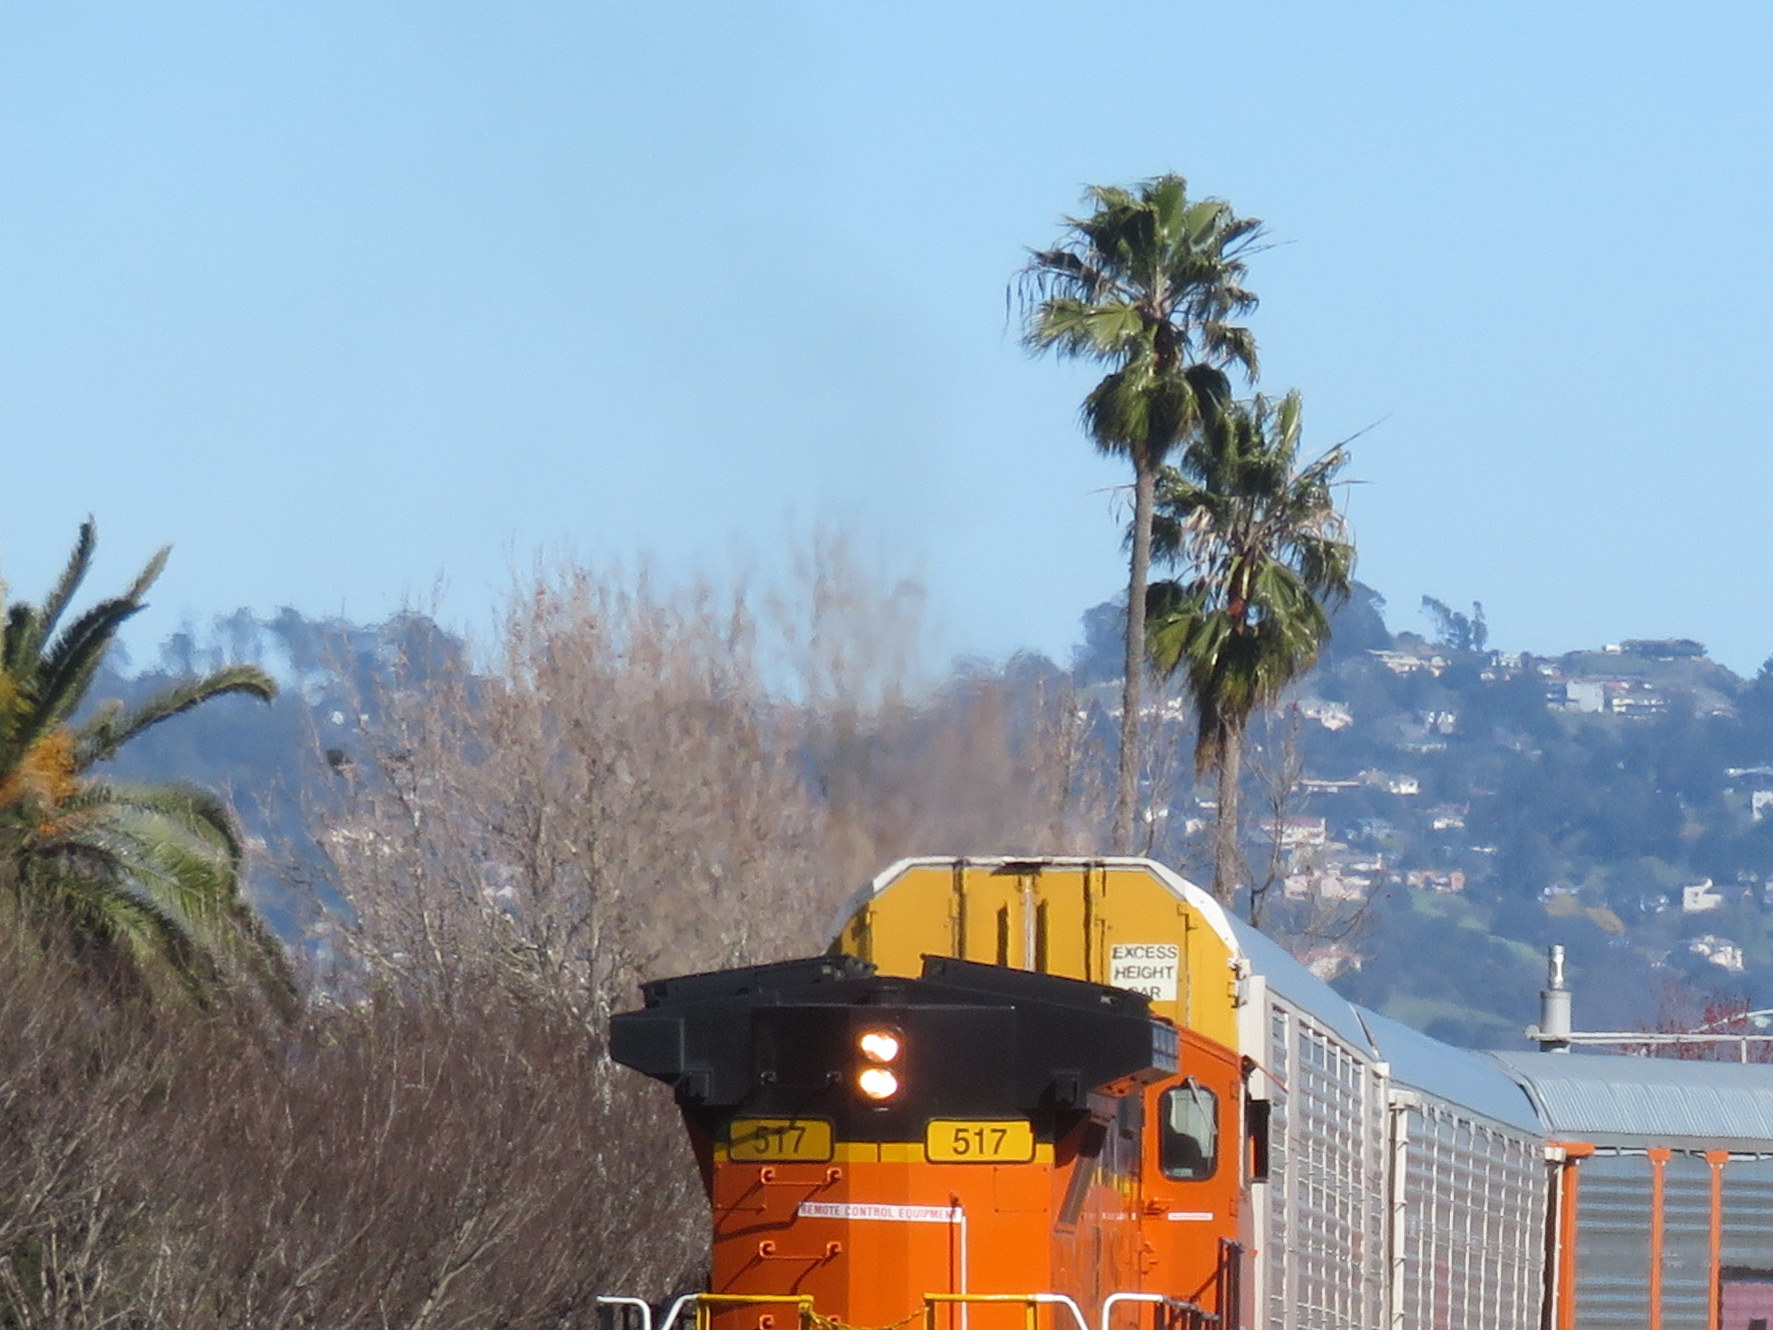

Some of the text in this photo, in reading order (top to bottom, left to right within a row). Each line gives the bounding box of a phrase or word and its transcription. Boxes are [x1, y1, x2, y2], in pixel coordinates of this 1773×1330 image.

[1112, 946, 1177, 959] EXCESS
[1114, 965, 1174, 980] HEIGHT
[753, 1126, 807, 1154] 517
[952, 1127, 1007, 1155] 517
[801, 1204, 958, 1220] REMOTE CONTROL EQUIPMENT
